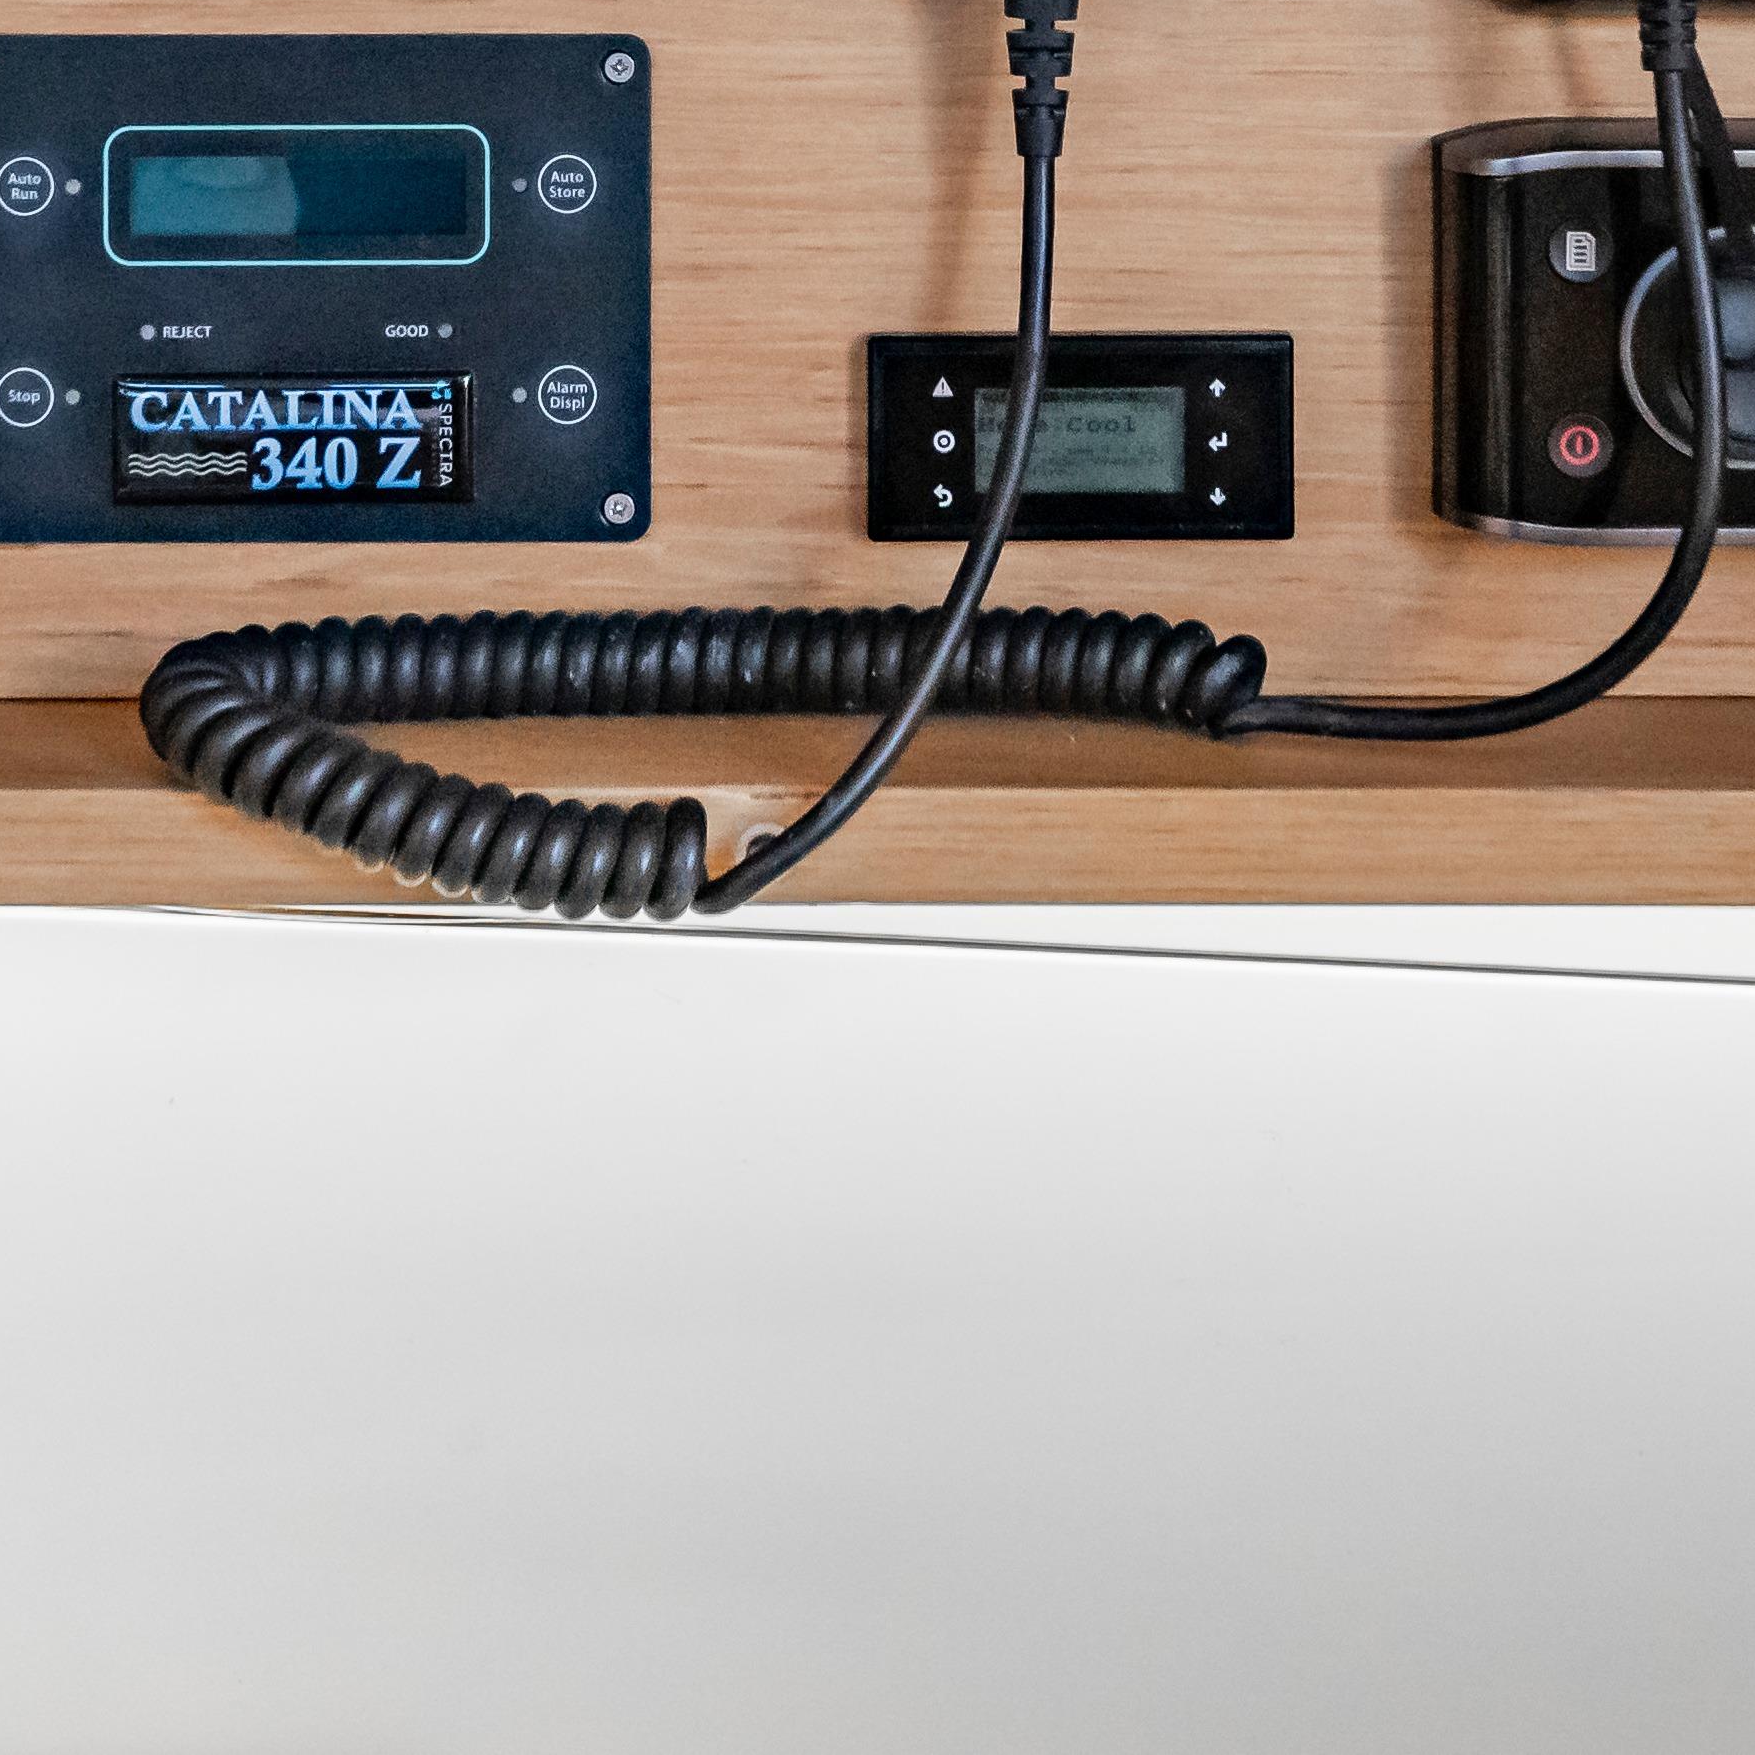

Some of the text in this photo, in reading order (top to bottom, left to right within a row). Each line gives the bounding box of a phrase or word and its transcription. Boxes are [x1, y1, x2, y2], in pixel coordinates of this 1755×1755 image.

[7, 173, 42, 184] Auto
[550, 171, 584, 183] Auto
[11, 187, 39, 199] Run
[549, 185, 585, 198] Store
[162, 324, 212, 339] REJECT
[385, 324, 429, 338] GOOD
[547, 381, 588, 394] Alarm
[8, 389, 41, 405] Stop
[550, 396, 585, 411] Displ
[129, 389, 423, 432] CATALINA
[439, 404, 453, 487] SPECTRA
[251, 437, 358, 491] 340
[375, 437, 422, 489] Z
